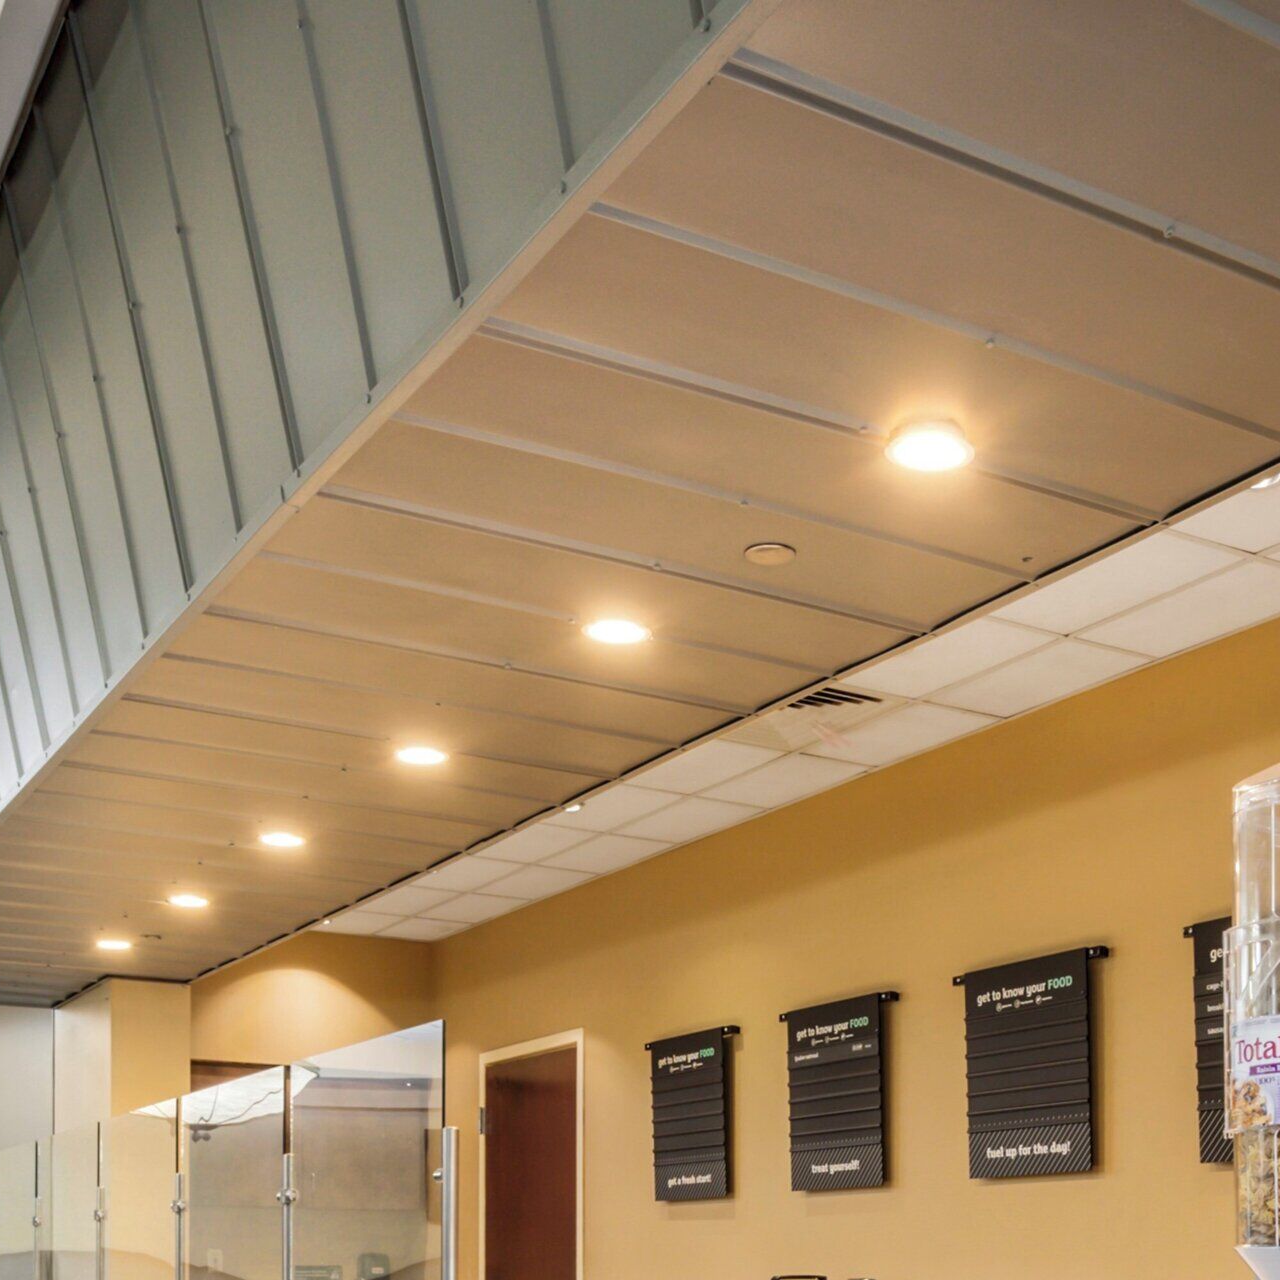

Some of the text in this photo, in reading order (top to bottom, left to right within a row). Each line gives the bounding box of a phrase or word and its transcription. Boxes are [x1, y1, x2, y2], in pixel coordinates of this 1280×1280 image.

[1210, 948, 1223, 962] ge
[977, 992, 990, 1007] get
[992, 990, 1001, 1001] to
[1003, 988, 1024, 999] know
[1026, 982, 1046, 997] your
[1048, 976, 1072, 990] FOOD
[796, 1027, 807, 1042] get
[808, 1028, 815, 1037] to
[817, 1026, 832, 1035] know
[834, 1022, 848, 1034] your
[850, 1017, 868, 1028] FOOD
[700, 1048, 714, 1057] FOOD
[987, 1142, 1070, 1159] fuel up for the day!
[812, 1160, 859, 1174] treat yourself!
